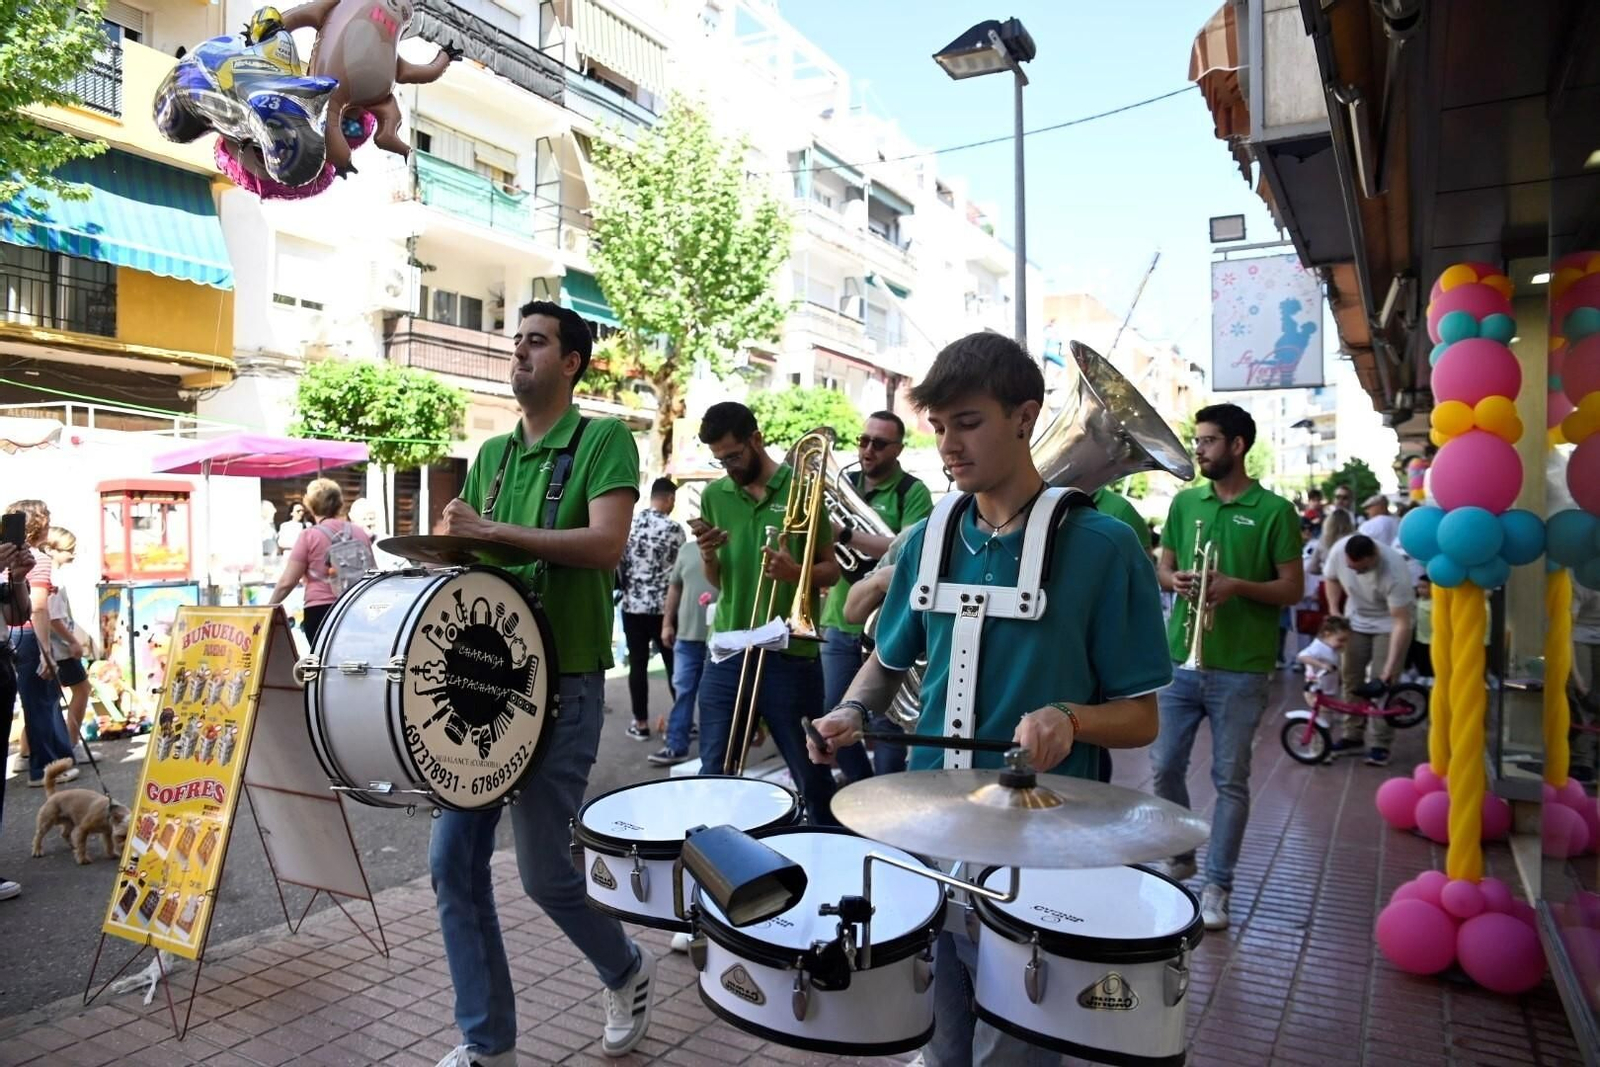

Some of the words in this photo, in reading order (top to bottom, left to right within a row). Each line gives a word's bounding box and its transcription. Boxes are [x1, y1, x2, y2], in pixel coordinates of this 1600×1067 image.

[257, 94, 281, 110] 23
[182, 620, 252, 652] BUÑUELOS
[458, 645, 505, 669] CHARANGA
[406, 724, 459, 792] 697378931
[471, 745, 529, 795] 678693532
[145, 778, 226, 806] GOFRES
